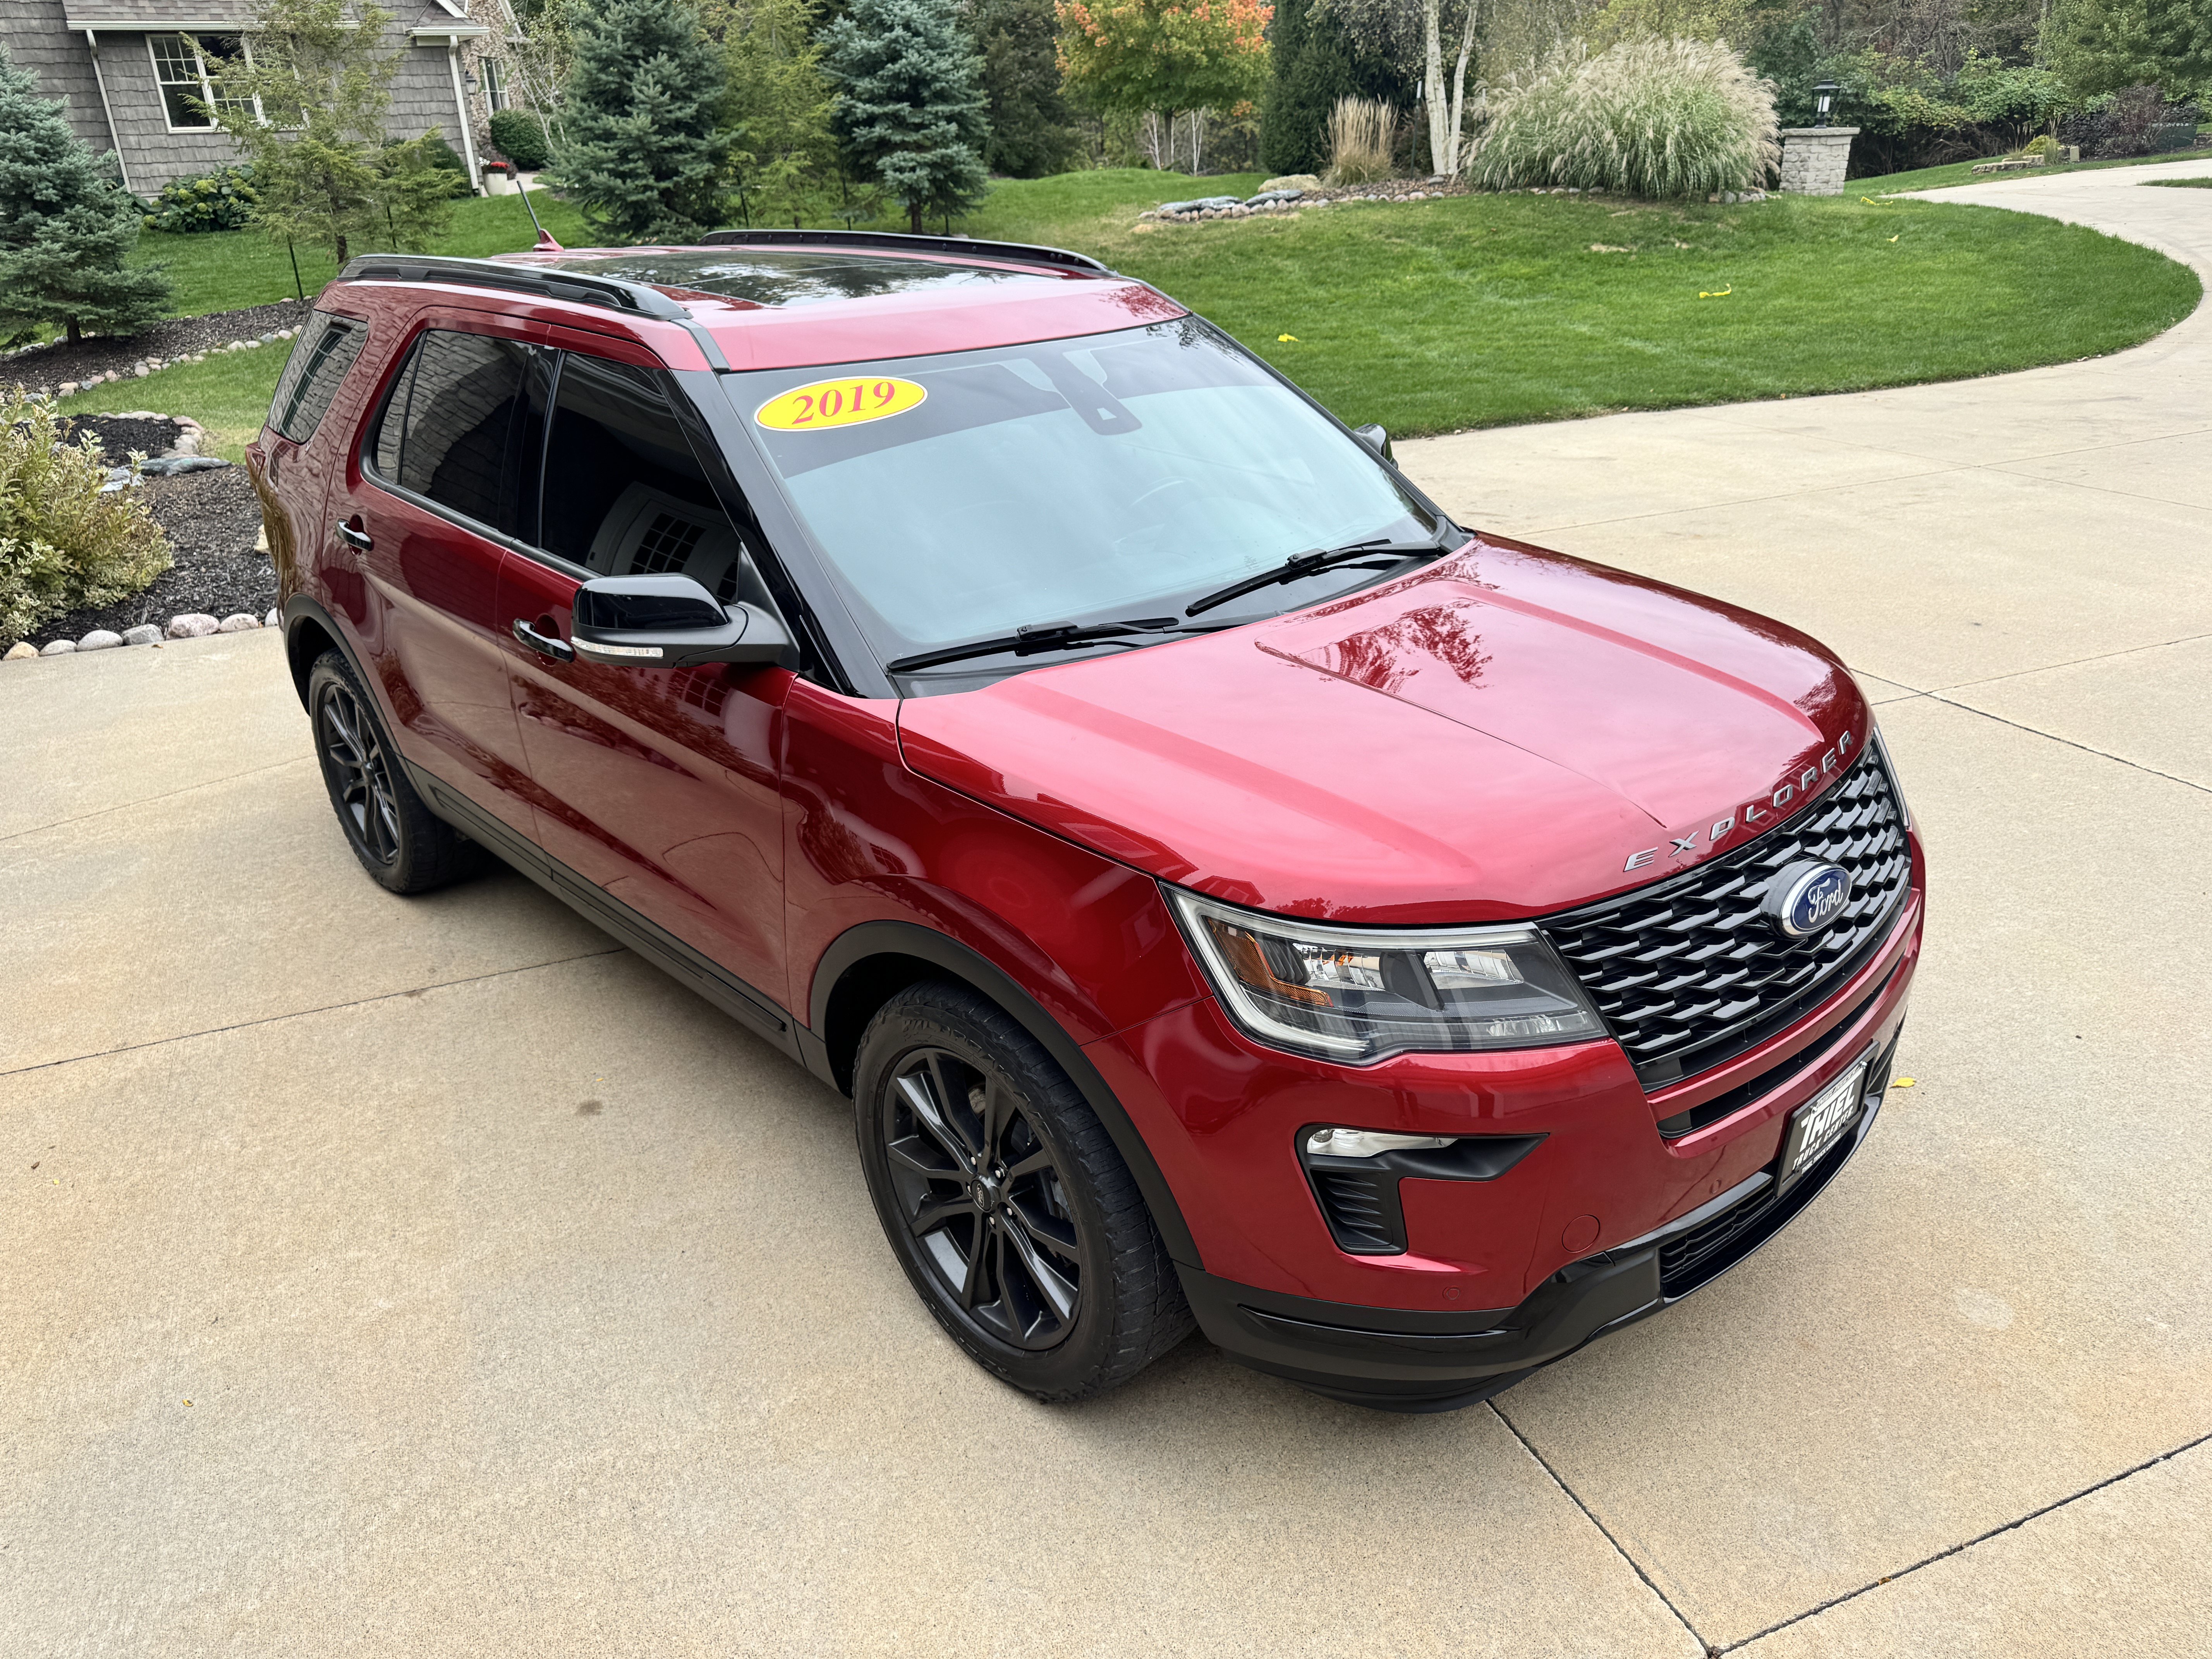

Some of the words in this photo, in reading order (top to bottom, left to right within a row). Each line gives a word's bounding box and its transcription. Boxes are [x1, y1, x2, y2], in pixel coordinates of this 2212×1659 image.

[792, 382, 895, 425] 2019
[1623, 730, 1852, 872] EXPLORER
[1808, 878, 1843, 923] Ford
[1792, 1137, 1822, 1170] TRUCK
[1823, 1106, 1853, 1142] CENTER
[1800, 1068, 1863, 1152] THIEL
